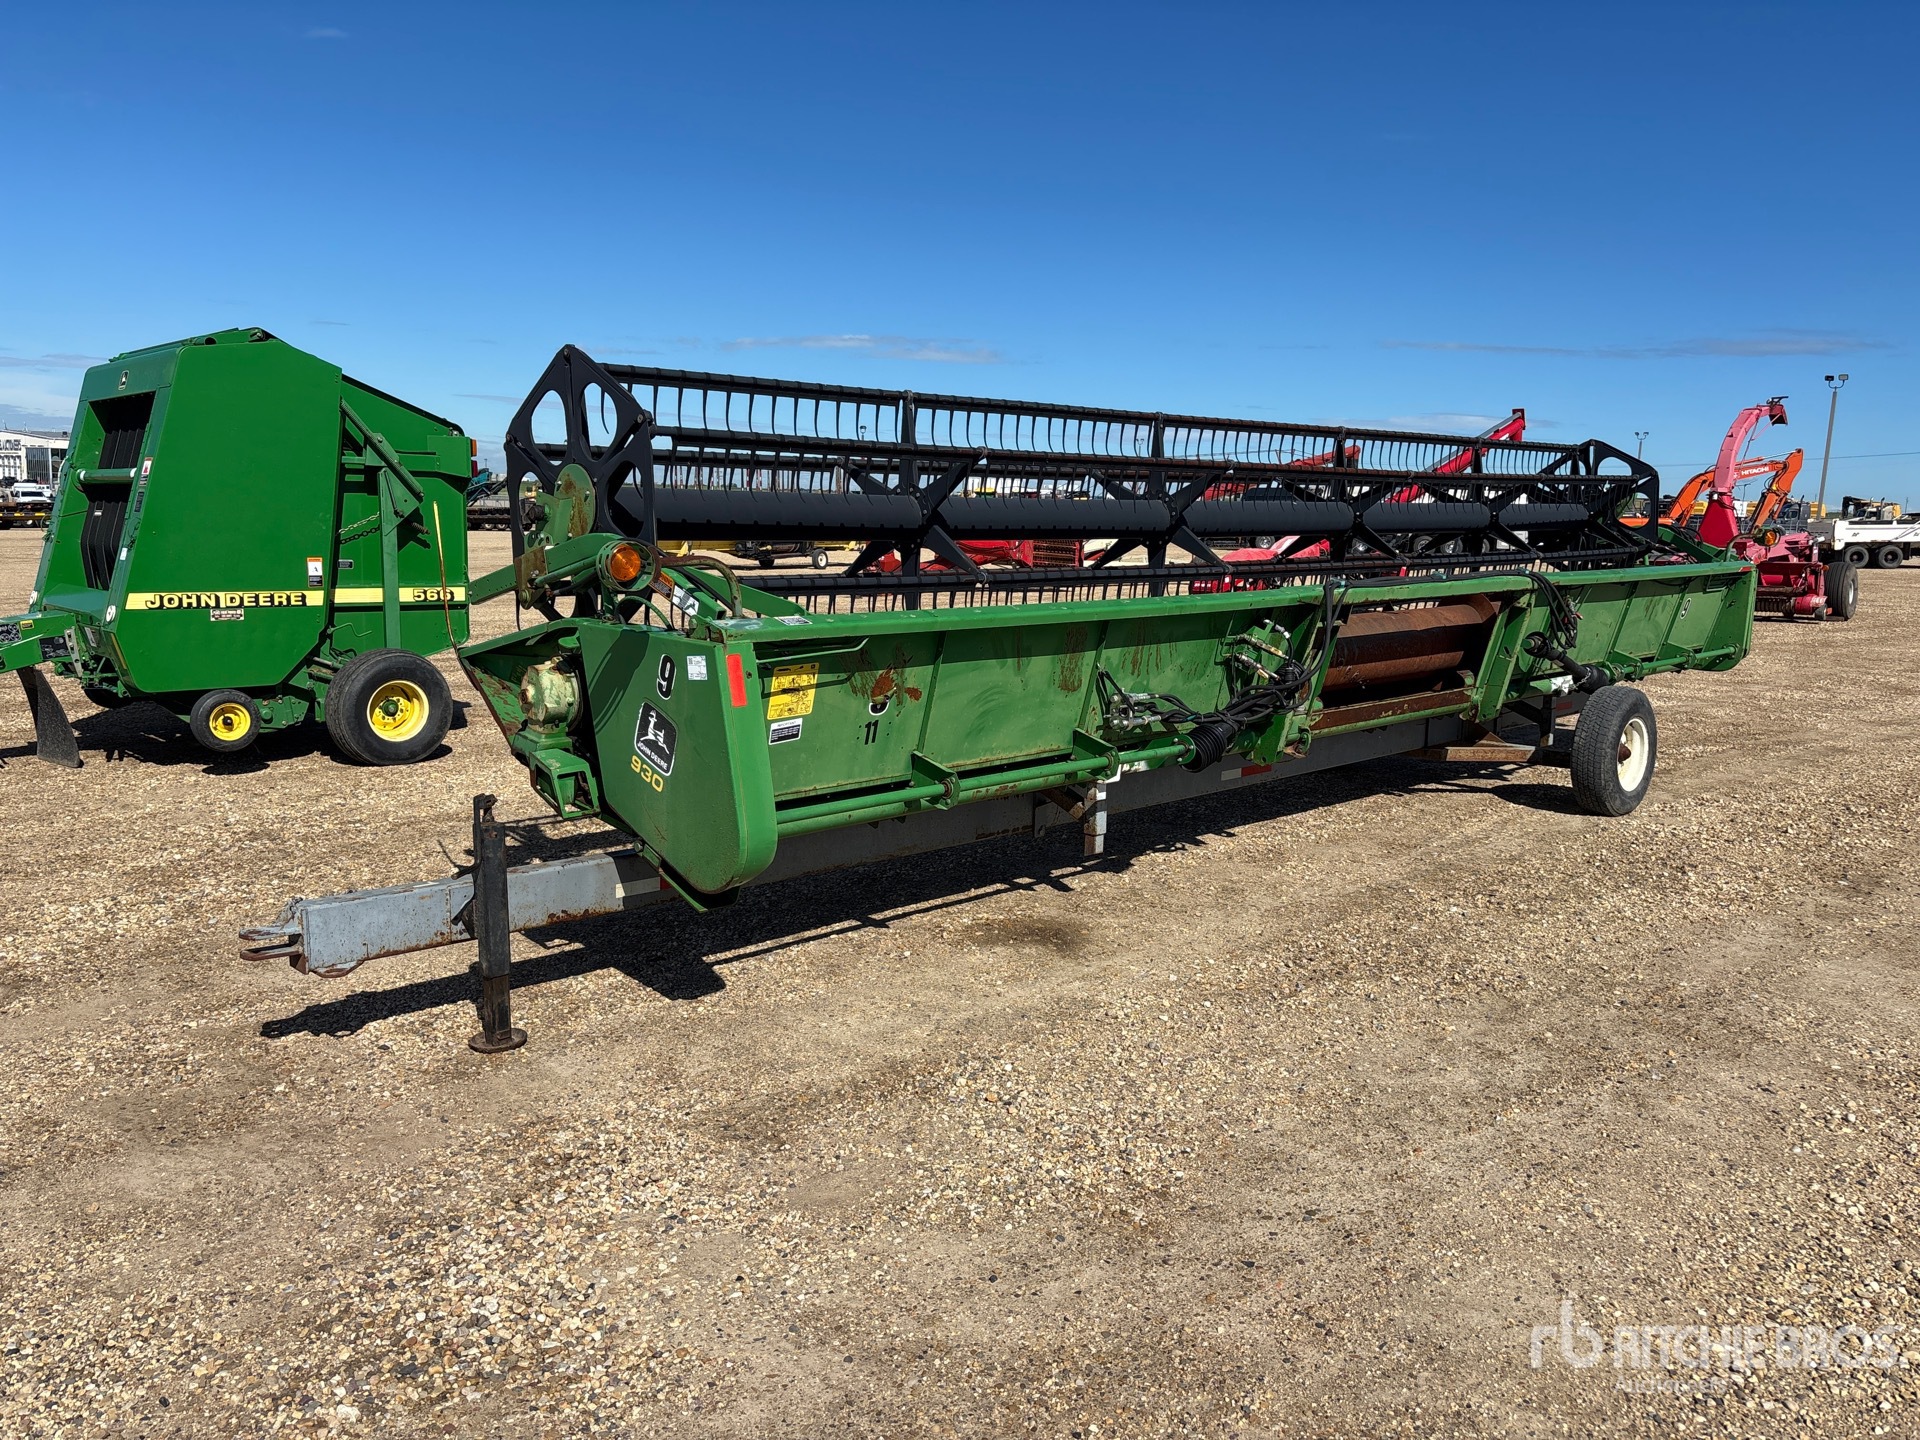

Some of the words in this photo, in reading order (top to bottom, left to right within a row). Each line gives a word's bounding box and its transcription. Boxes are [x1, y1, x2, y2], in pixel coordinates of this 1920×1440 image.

[1741, 466, 1770, 476] HITACHI
[145, 593, 220, 609] JOHN
[225, 592, 307, 608] DEERE
[413, 588, 455, 602] 566
[1680, 598, 1692, 619] 9
[656, 654, 676, 700] 9
[864, 719, 879, 745] 11
[637, 740, 652, 757] JOHN
[650, 750, 669, 771] DEERE
[630, 755, 664, 792] 930
